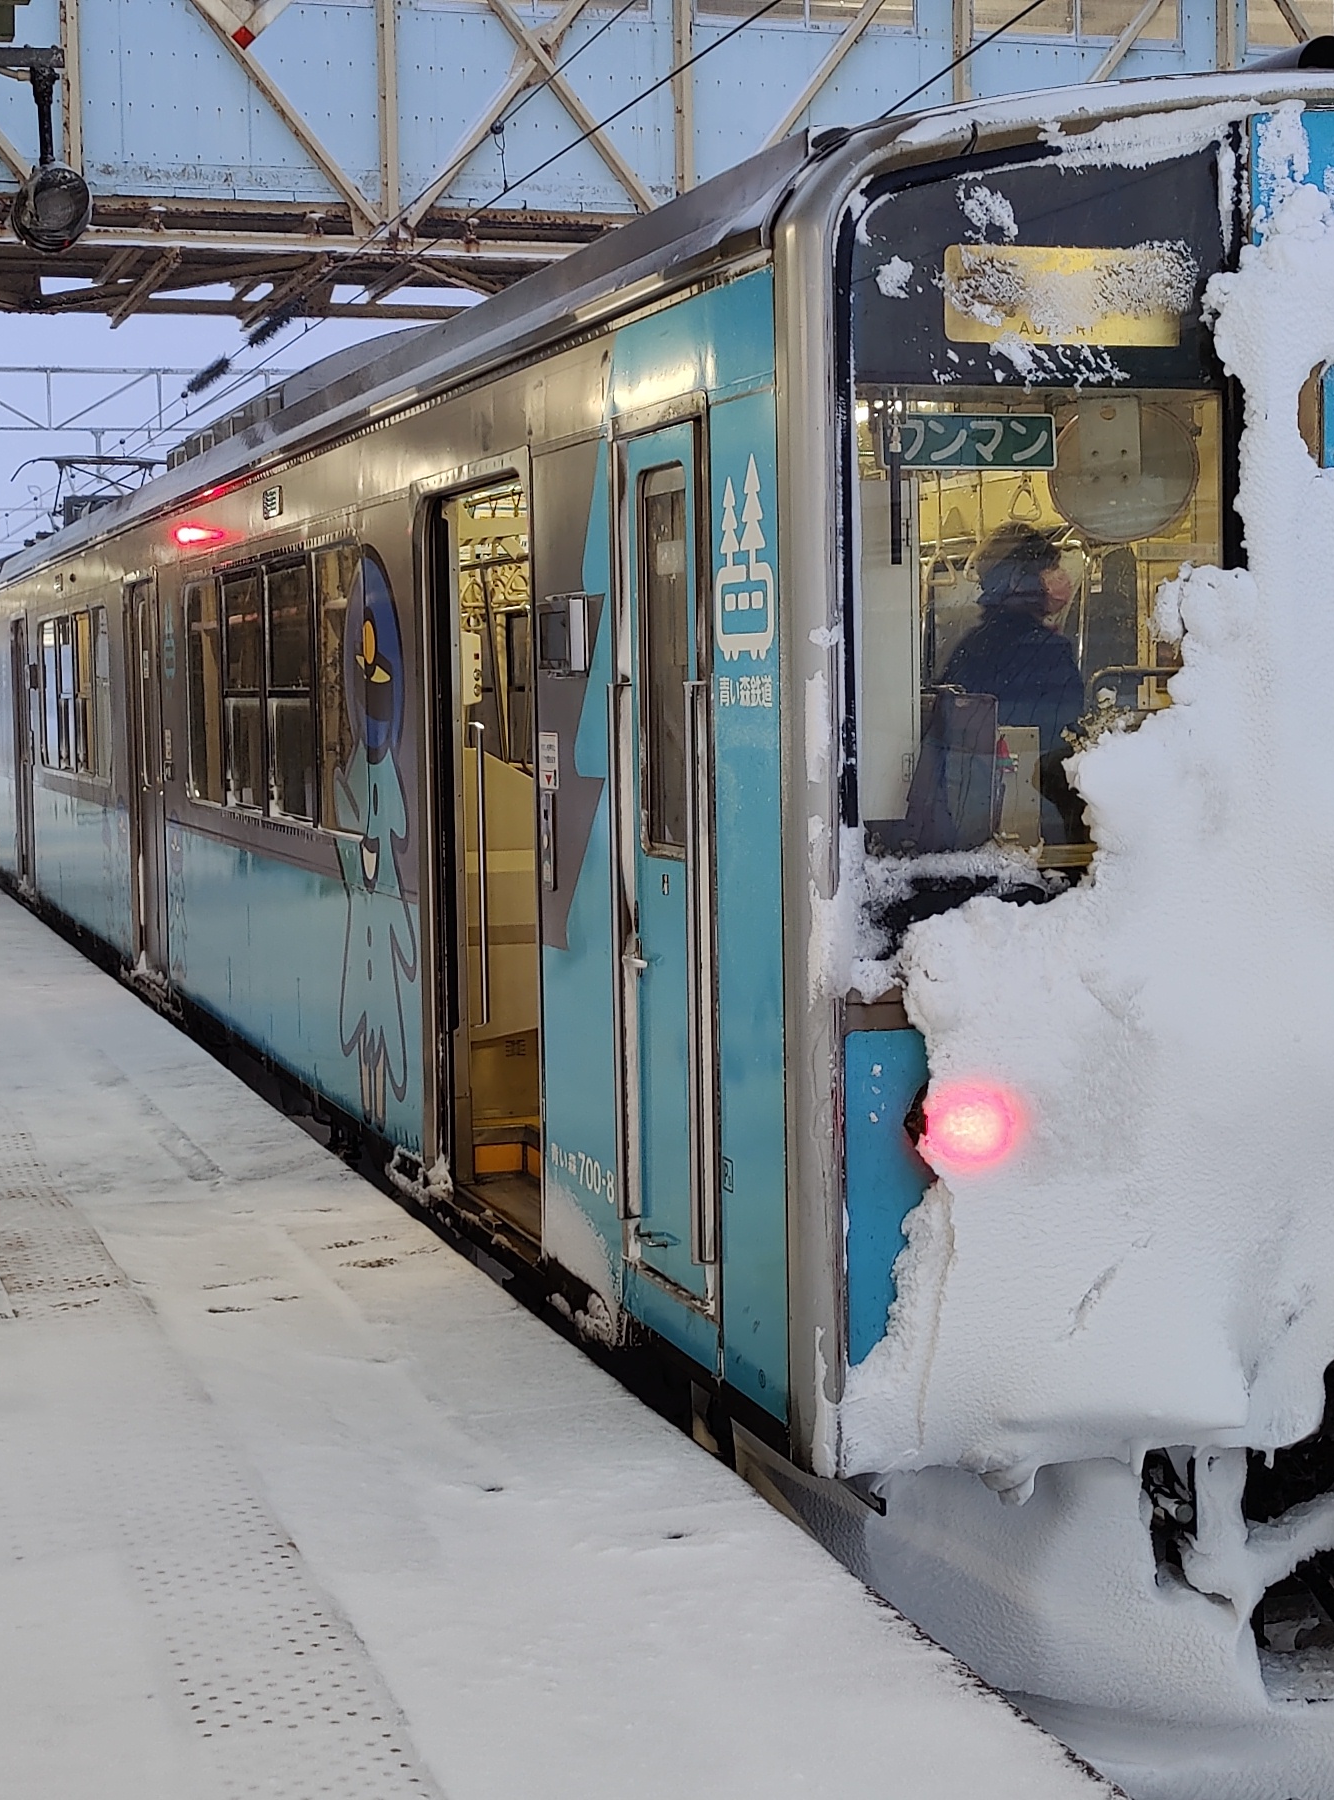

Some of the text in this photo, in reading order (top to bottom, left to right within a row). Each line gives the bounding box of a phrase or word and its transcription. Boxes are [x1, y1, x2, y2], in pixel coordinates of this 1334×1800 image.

[891, 419, 1049, 462] ワンマン
[719, 674, 773, 708] 青い森鉄道
